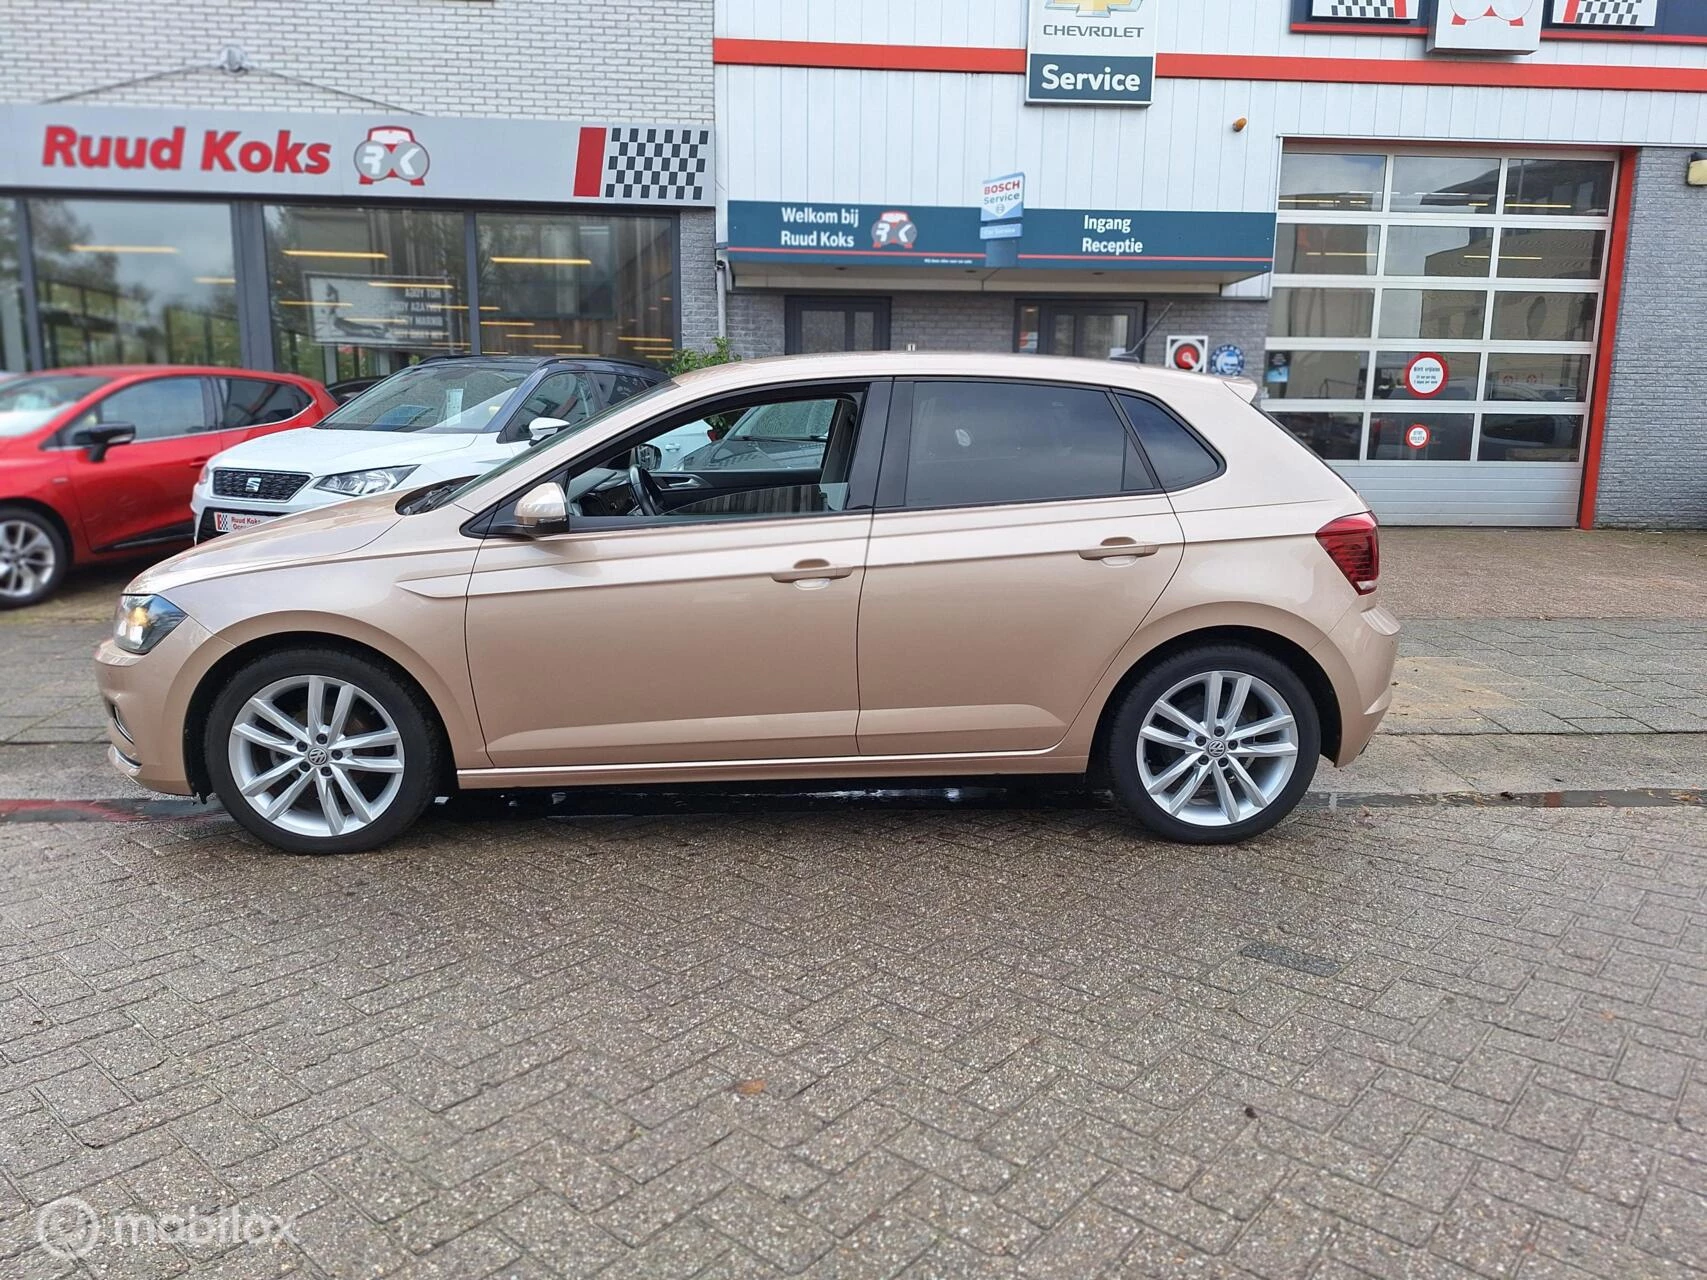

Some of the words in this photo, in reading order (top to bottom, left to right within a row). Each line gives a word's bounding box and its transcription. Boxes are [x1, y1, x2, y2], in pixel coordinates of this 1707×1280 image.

[1043, 24, 1144, 38] CHEVROLET
[1041, 64, 1141, 91] Service
[42, 125, 186, 170] Ruud
[200, 130, 332, 174] Koks
[984, 180, 1020, 195] BOSCH
[983, 192, 1020, 205] Service
[781, 207, 838, 223] Welkom
[841, 208, 859, 228] bij
[1083, 214, 1131, 233] Ingang
[781, 230, 817, 246] Ruud
[820, 231, 855, 247] Koks
[1082, 237, 1143, 256] Receptie
